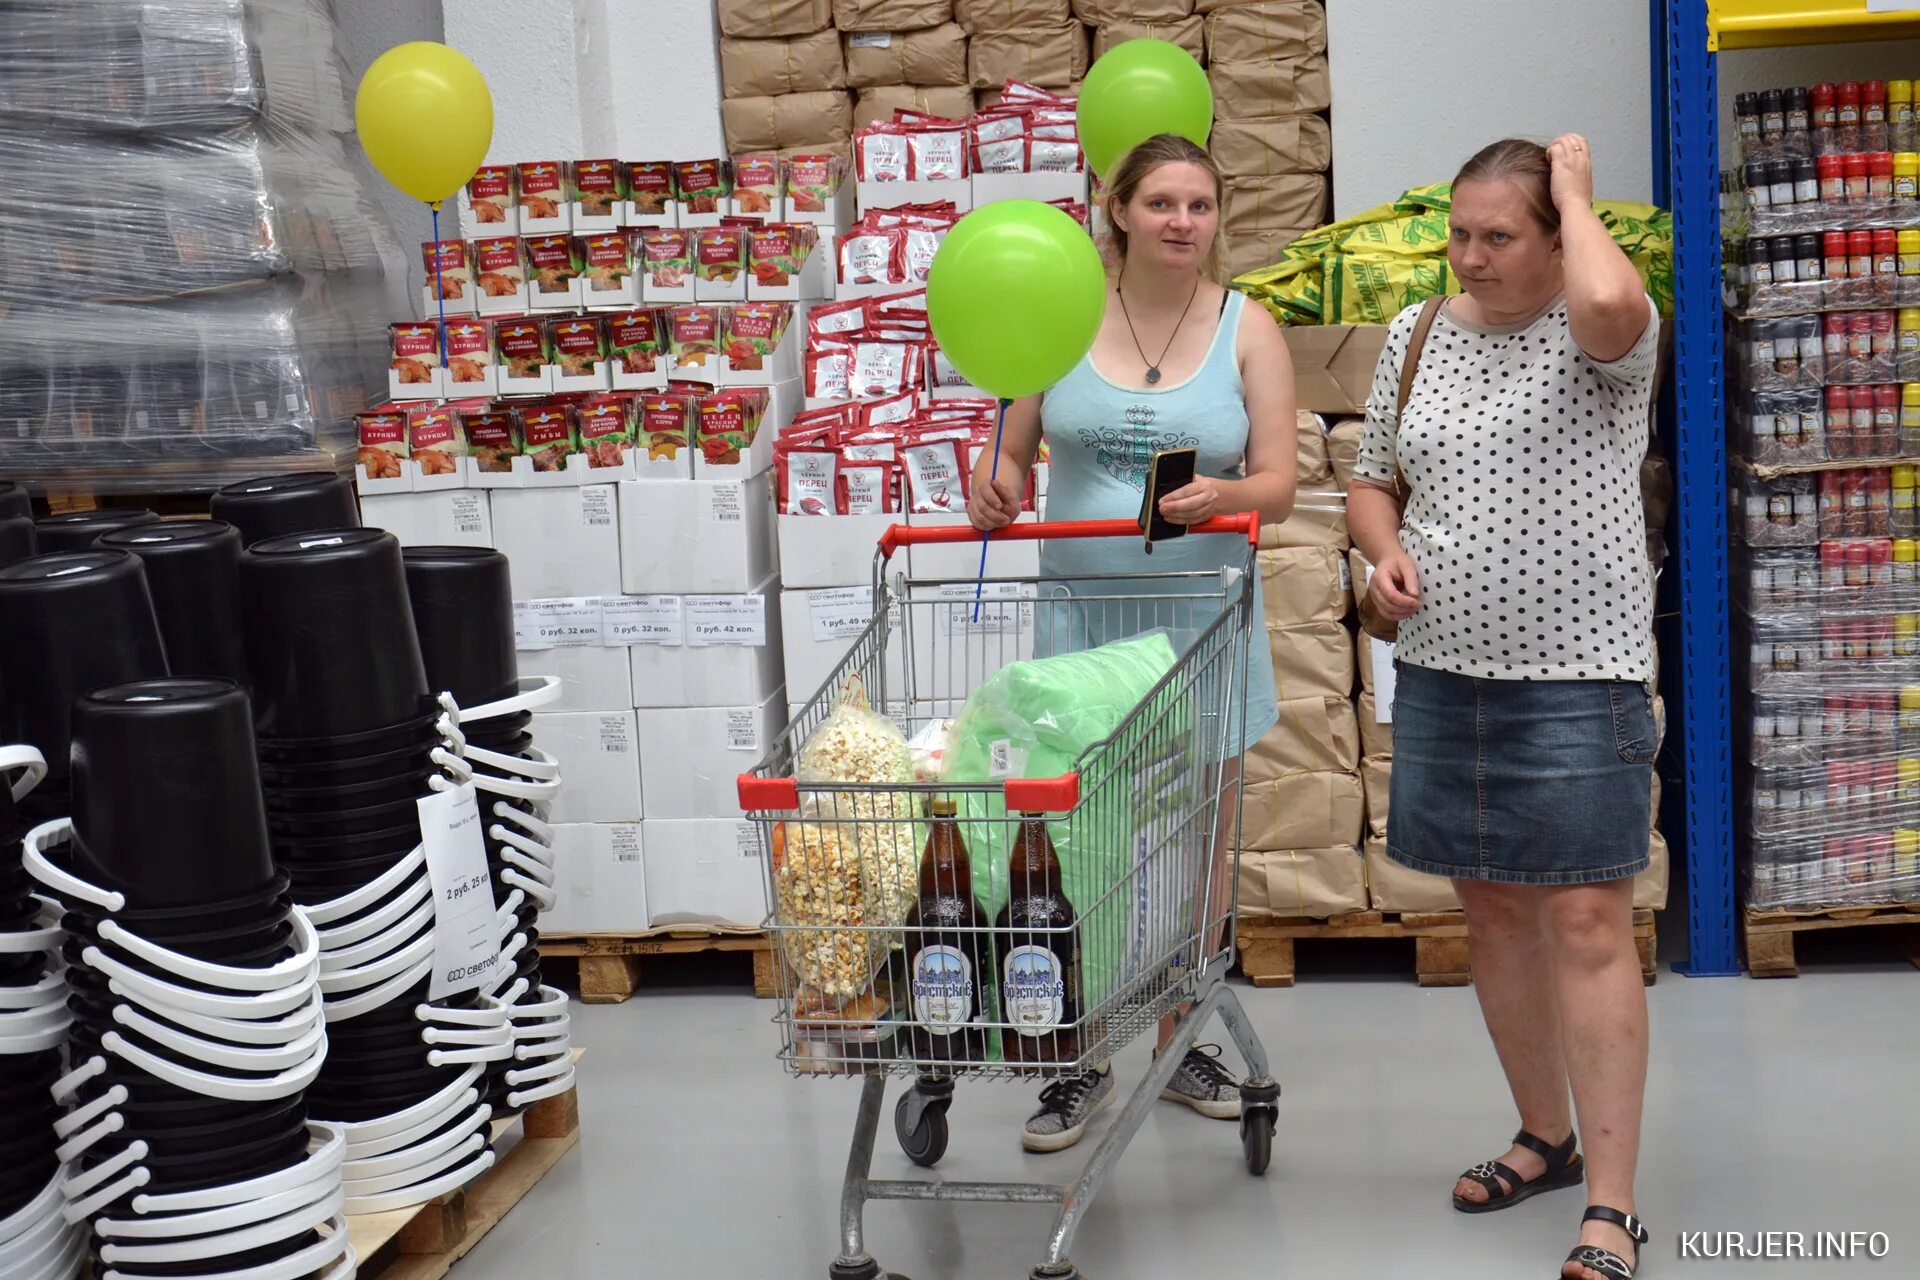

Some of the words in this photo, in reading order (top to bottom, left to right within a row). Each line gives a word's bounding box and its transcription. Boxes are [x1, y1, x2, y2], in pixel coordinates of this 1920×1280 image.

[925, 155, 953, 163] ПЕРЕЦ
[992, 164, 1019, 173] ПЕРЕЦ
[1369, 264, 1390, 292] ЛИСТ
[1349, 264, 1384, 324] ЛАВРОВЫЙ
[865, 369, 893, 377] ПЕРЕЦ
[418, 432, 447, 441] КУРИЦЫ
[920, 470, 949, 480] ПЕРЕЦ
[799, 479, 827, 488] ПЕРЕЦ
[829, 620, 847, 628] руб.
[548, 628, 565, 636] руб.
[622, 626, 640, 634] руб.
[704, 626, 721, 634] руб.
[447, 889, 452, 900] 2
[454, 882, 470, 899] руб.
[472, 876, 480, 888] 25
[467, 952, 498, 975] светофо
